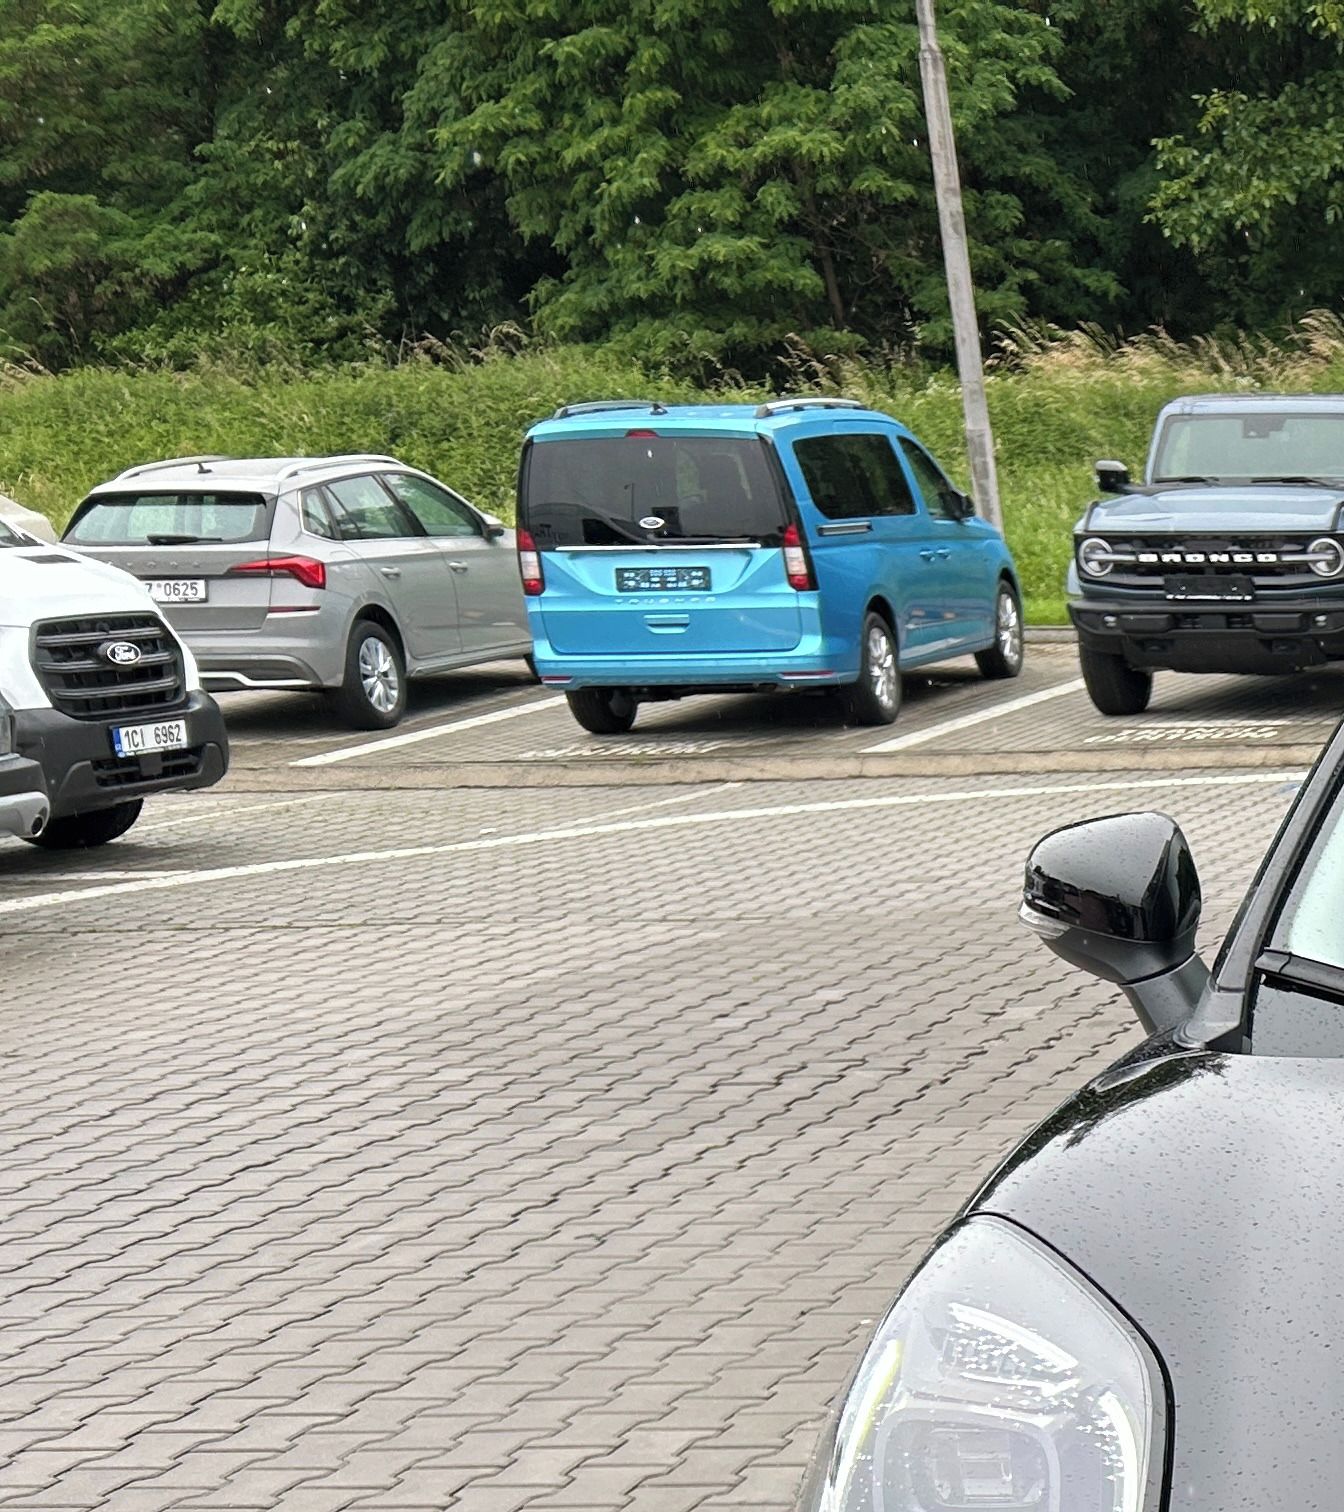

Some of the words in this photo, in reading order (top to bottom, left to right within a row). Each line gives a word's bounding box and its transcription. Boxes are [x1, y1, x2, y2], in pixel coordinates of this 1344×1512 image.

[1138, 553, 1277, 563] BRONCO
[163, 582, 198, 597] 0625
[153, 723, 182, 745] 6962
